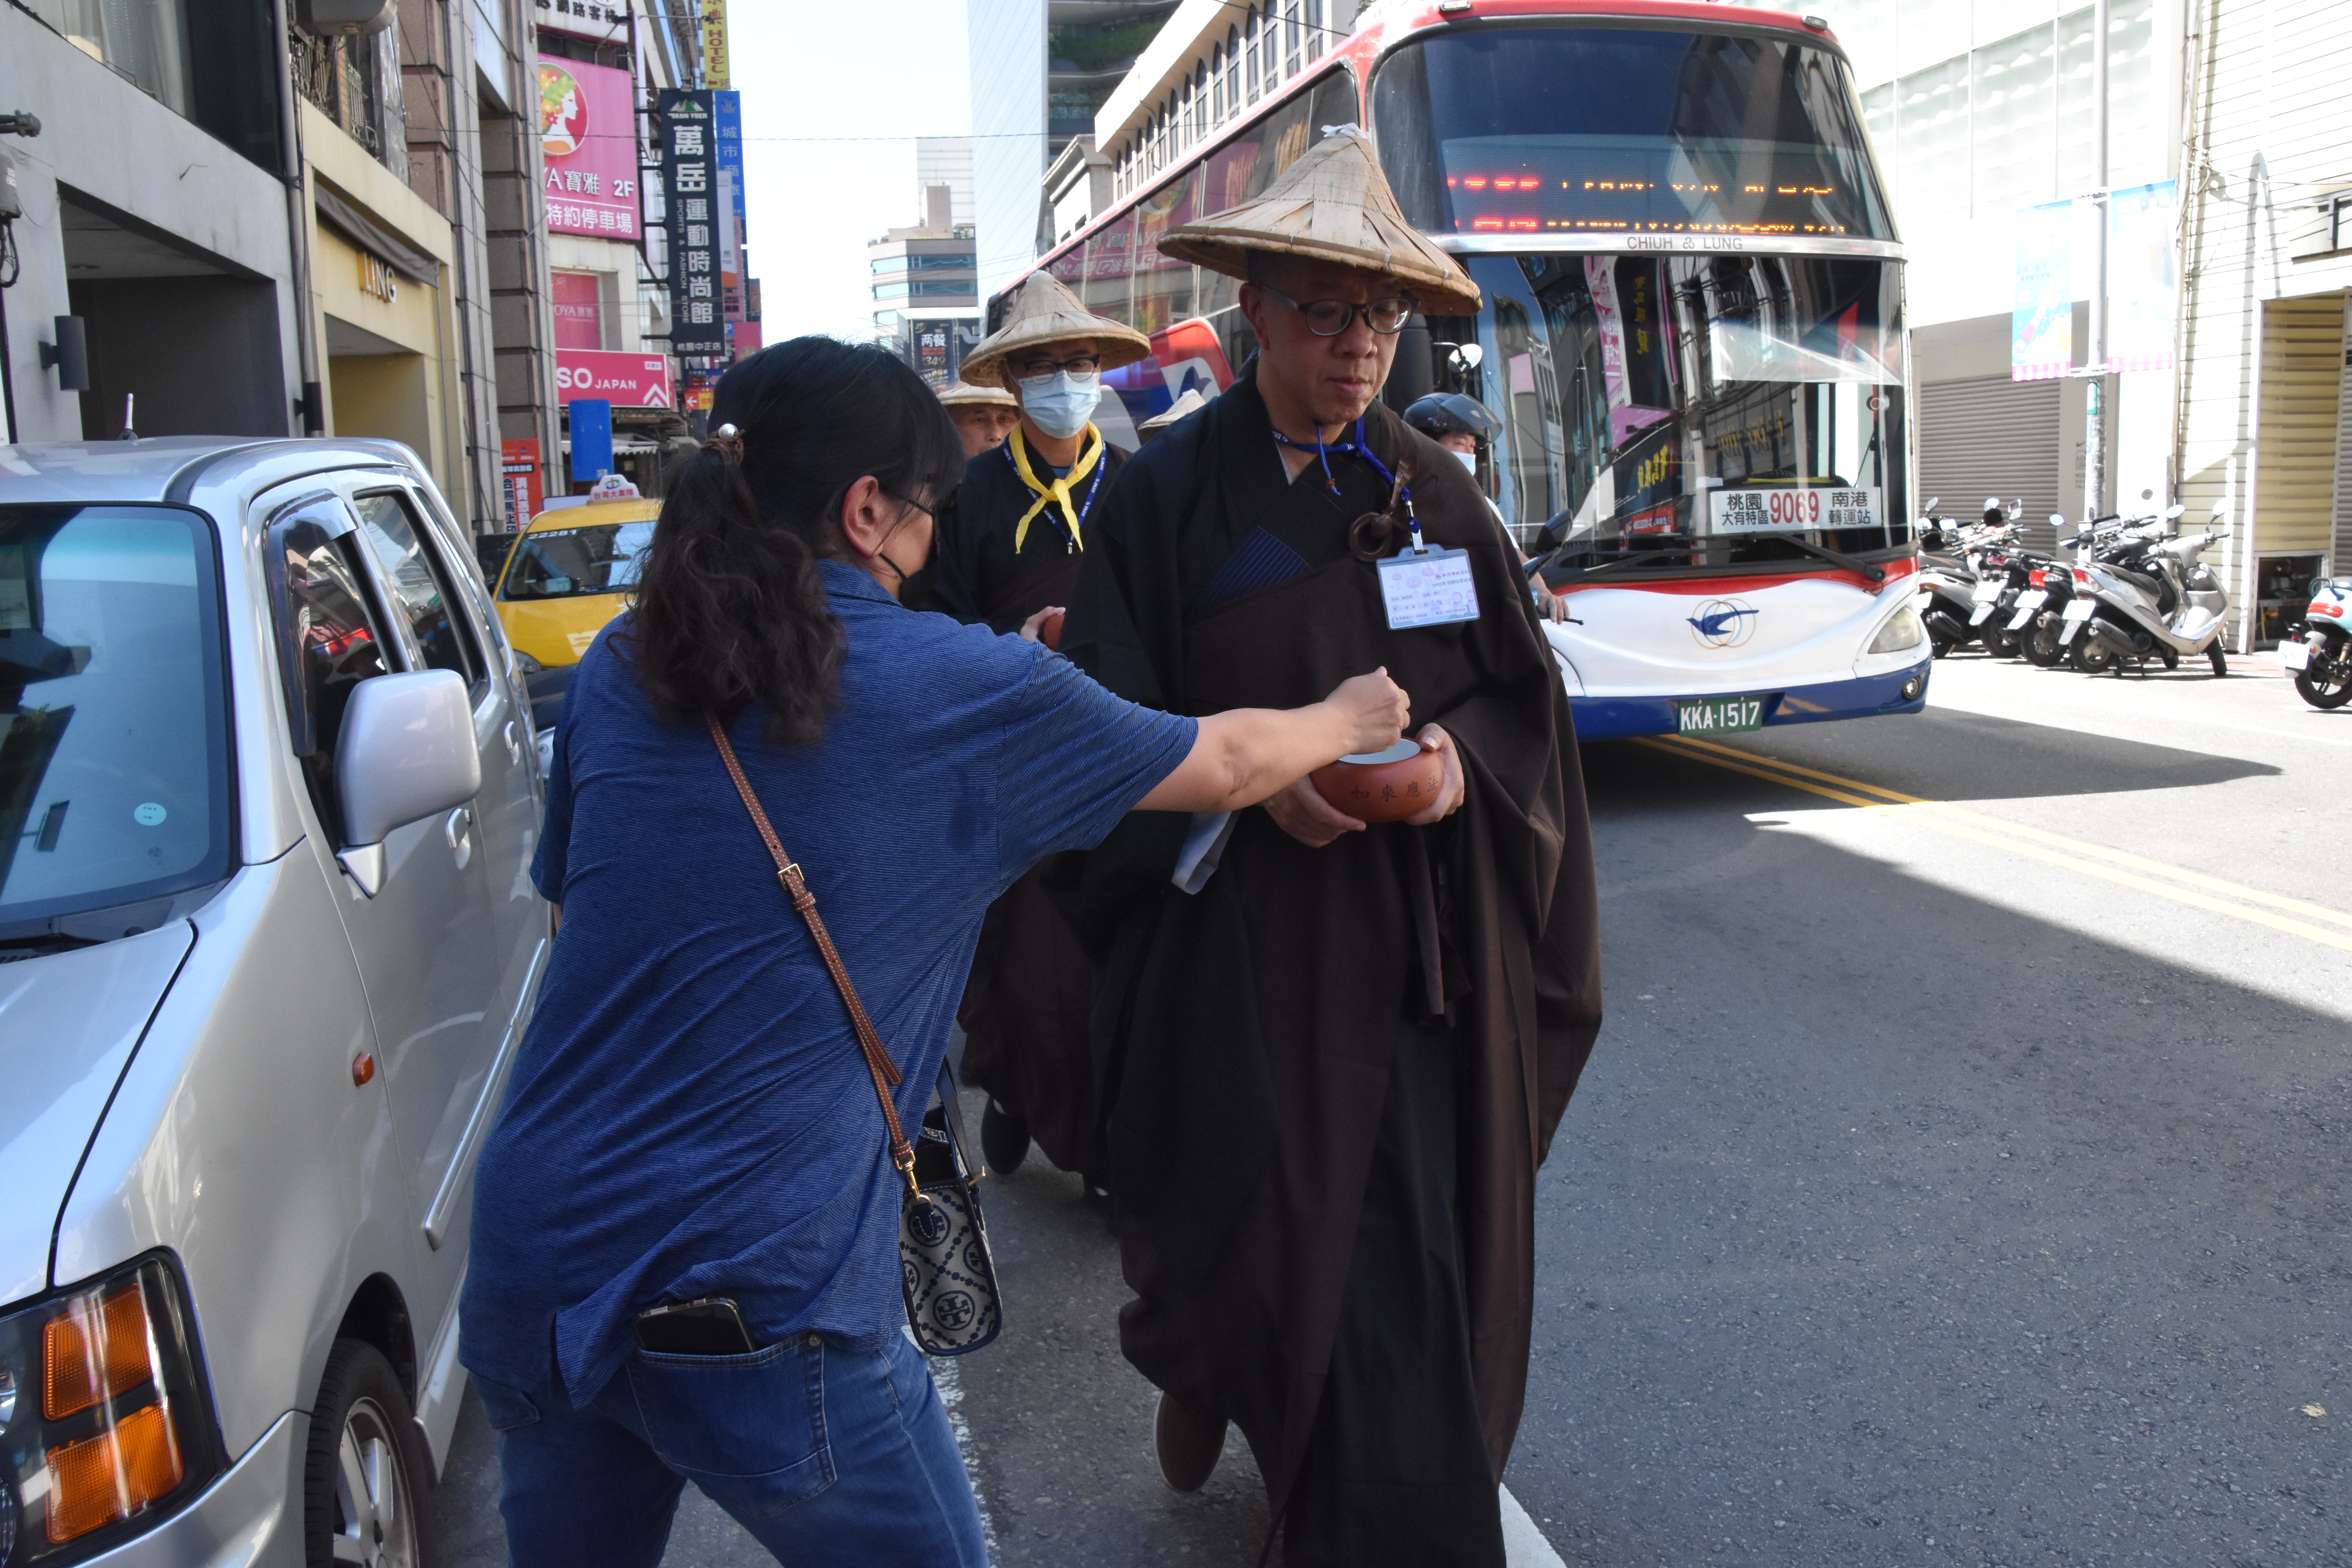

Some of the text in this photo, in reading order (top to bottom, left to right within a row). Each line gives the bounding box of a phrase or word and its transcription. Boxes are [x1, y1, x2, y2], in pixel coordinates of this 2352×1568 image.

[708, 29, 724, 73] HOTEL
[564, 170, 600, 195] 寶雅
[613, 180, 634, 197] 2F
[546, 203, 633, 233] 特約停車場
[1627, 237, 1673, 249] CHIUH
[1704, 237, 1743, 249] LUNG
[677, 199, 685, 233] SPORTS
[681, 296, 690, 323] STORE
[595, 379, 637, 389] JAPAN
[1722, 509, 1871, 526] 大有特區 轉運站
[1727, 492, 1868, 524] 桃園 9069 南港
